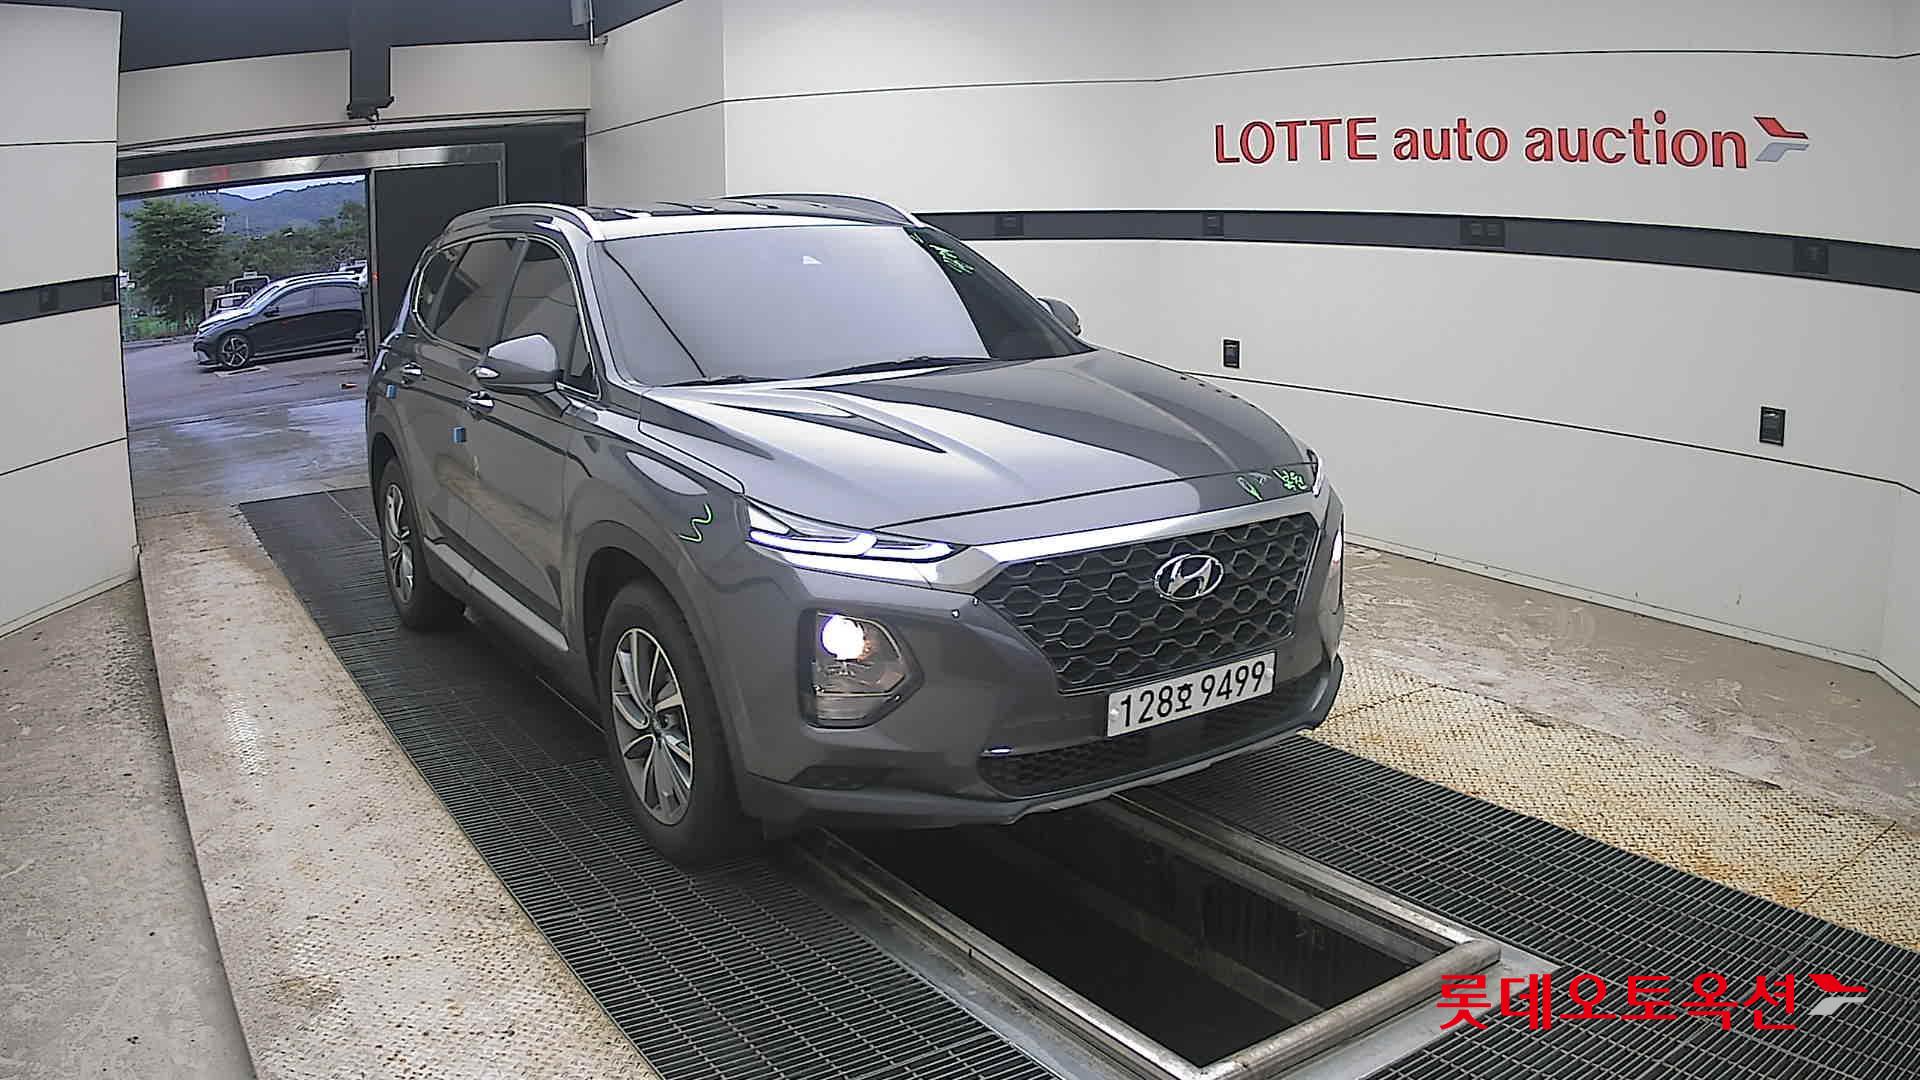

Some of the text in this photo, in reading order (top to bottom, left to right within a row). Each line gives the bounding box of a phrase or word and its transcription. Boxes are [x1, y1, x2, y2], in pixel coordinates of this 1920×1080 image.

[1215, 110, 1748, 168] LOTTE auto auction
[1120, 661, 1266, 727] 128호 9499
